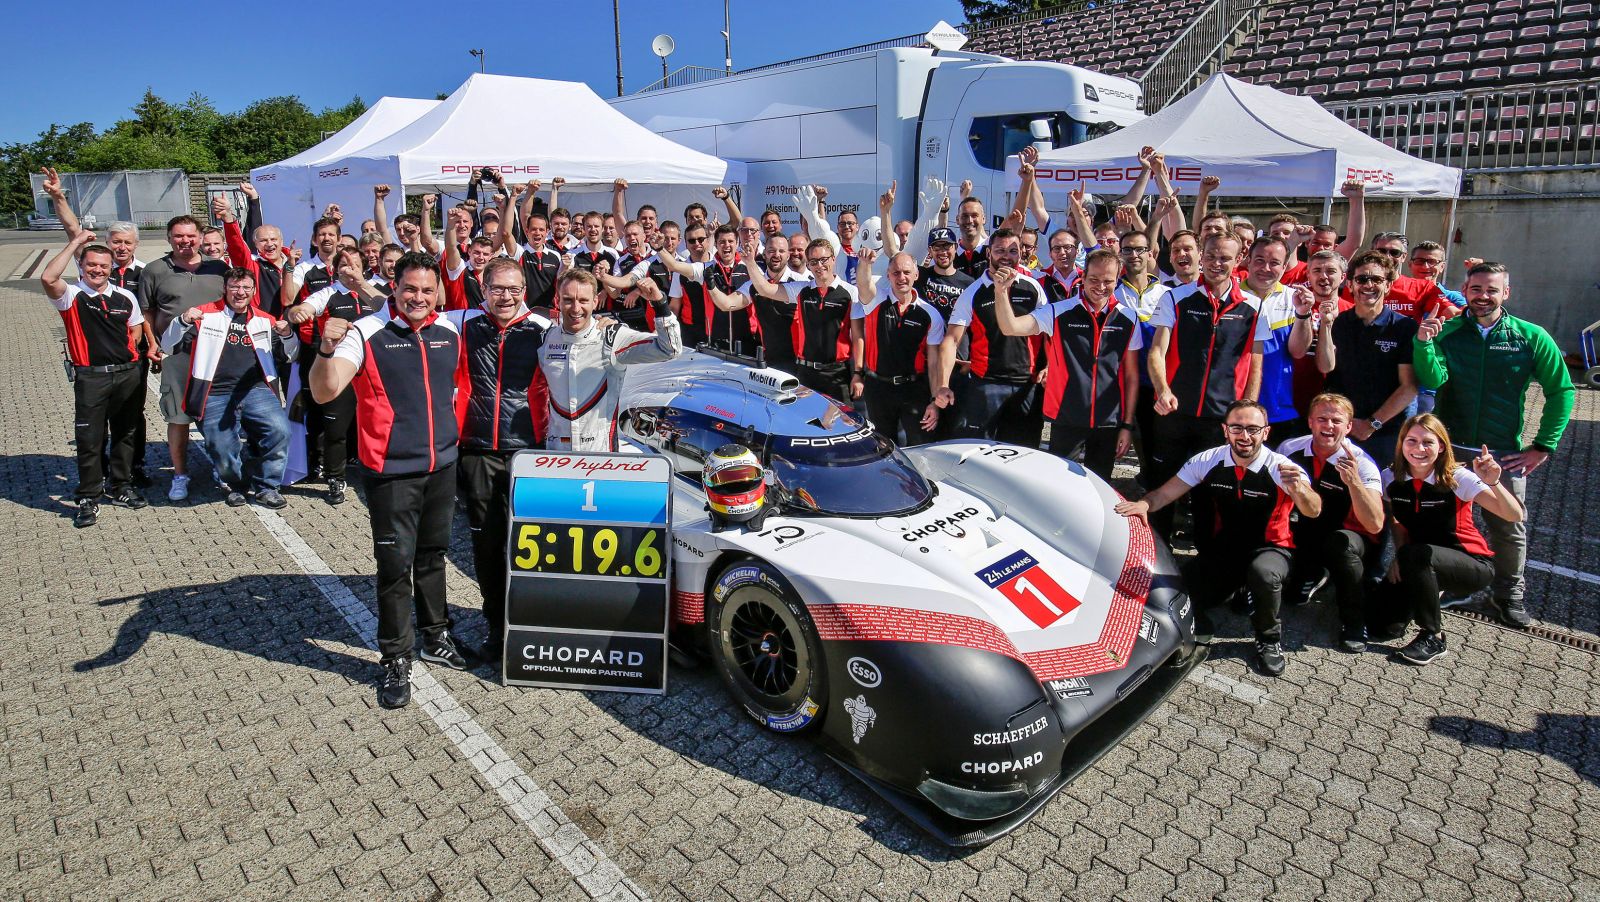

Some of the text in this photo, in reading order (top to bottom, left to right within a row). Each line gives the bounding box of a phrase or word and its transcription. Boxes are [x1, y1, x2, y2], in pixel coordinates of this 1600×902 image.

[1097, 87, 1134, 101] PORSCHE
[319, 167, 349, 178] PORSCHE
[1034, 167, 1202, 182] PORSCE
[535, 456, 650, 477] 919 hybrid
[581, 480, 598, 512] 1
[902, 506, 980, 543] CHOPARD
[672, 535, 705, 559] HOPARD
[725, 569, 758, 586] MICHELIN
[983, 556, 1033, 584] 24h LE MANS
[1014, 576, 1065, 617] 1
[522, 644, 645, 667] CHOPARD
[522, 664, 643, 678] OFFICIAL TIMING PARTNER
[1049, 677, 1080, 691] Mobil
[973, 716, 1049, 746] SCHAEFFLER
[961, 751, 1044, 774] CHOPARD
